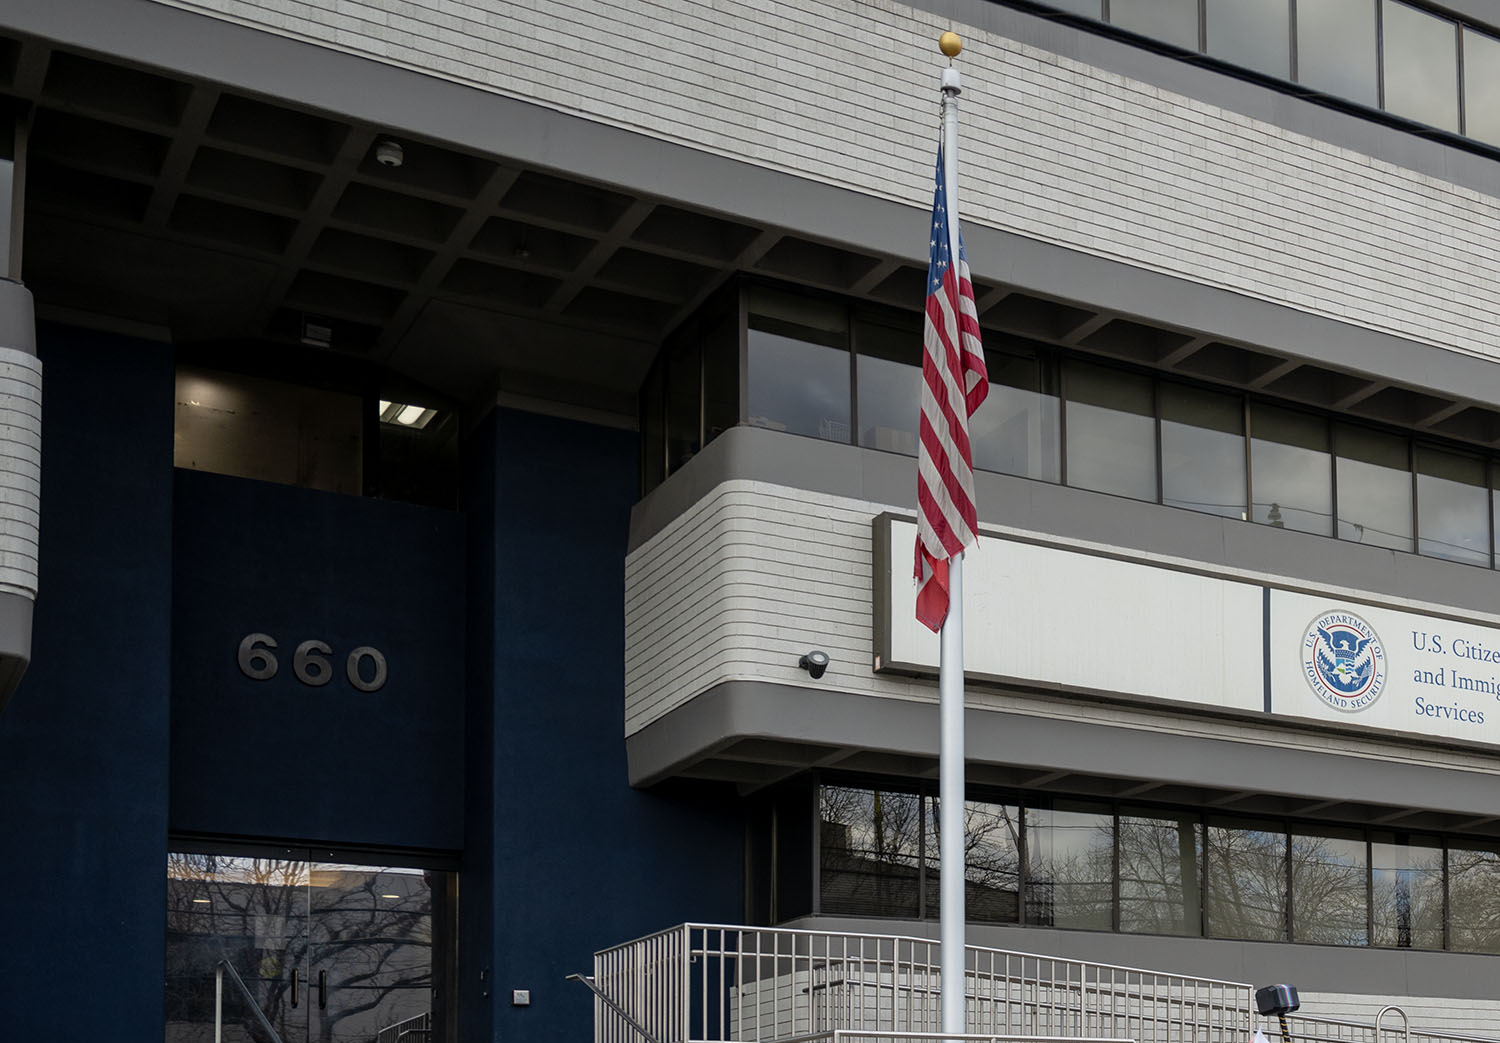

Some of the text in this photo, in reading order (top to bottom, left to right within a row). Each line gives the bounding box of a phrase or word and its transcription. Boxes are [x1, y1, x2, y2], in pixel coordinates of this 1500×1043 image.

[1306, 615, 1384, 660] U.S. DEPARTMENT OF
[1412, 630, 1447, 655] U.S.
[236, 632, 389, 693] 660
[1413, 667, 1446, 687] and
[1305, 660, 1384, 709] HOMELAND SECURITY
[1414, 696, 1485, 724] Services
